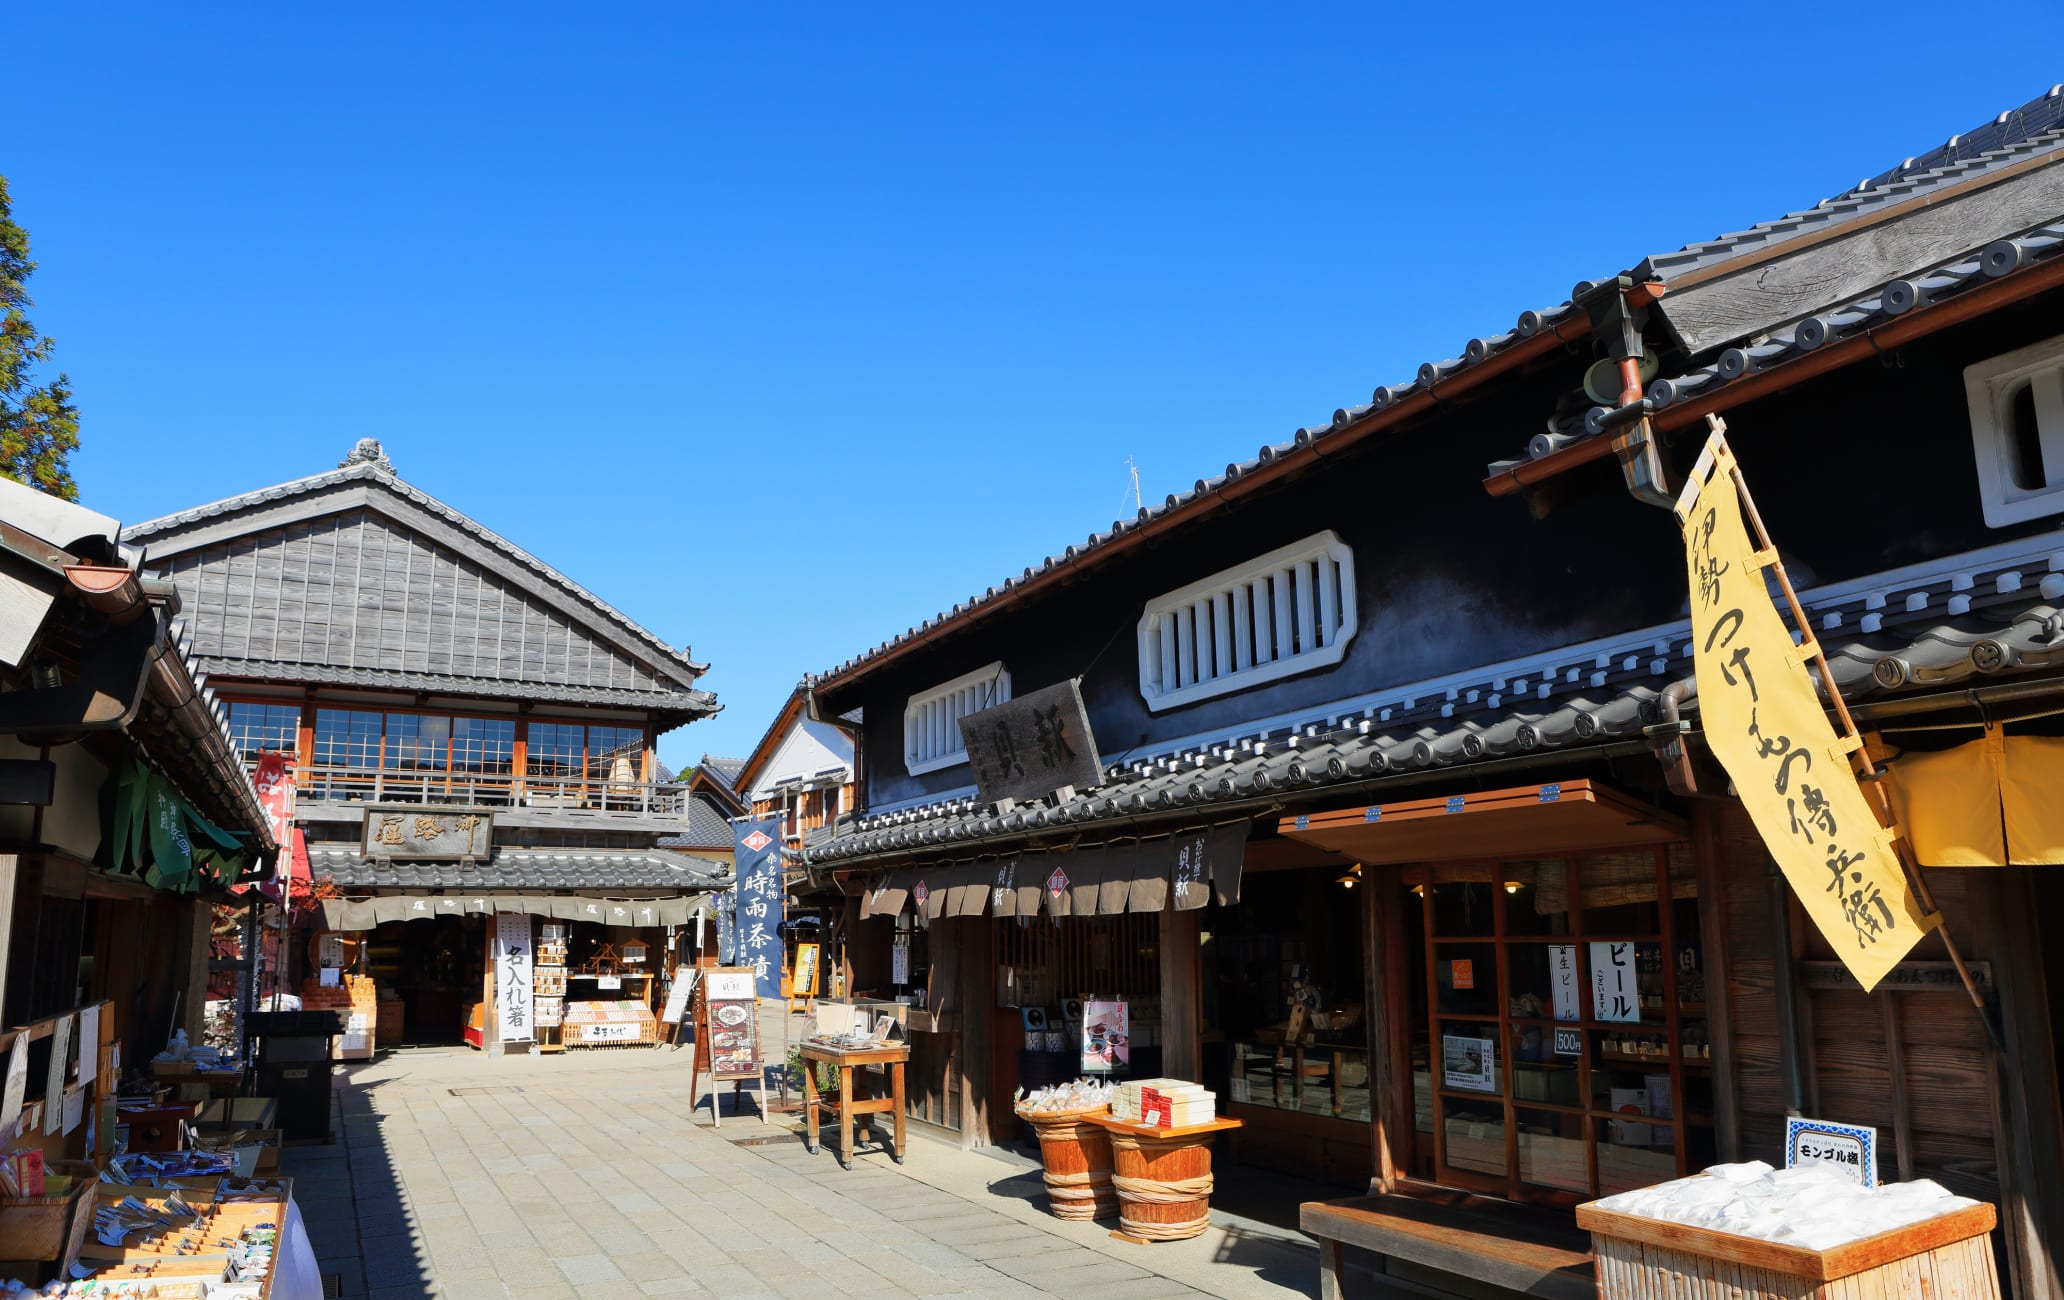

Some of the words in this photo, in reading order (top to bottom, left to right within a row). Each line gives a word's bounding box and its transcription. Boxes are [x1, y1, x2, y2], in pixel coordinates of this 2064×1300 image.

[766, 852, 779, 901] 桑名名物
[505, 944, 526, 1028] 名入れ箸
[1559, 956, 1575, 1019] 生ビール
[1609, 942, 1632, 1018] ビール
[1557, 1032, 1582, 1051] 500円
[1800, 1144, 1859, 1166] モンゴル塩
